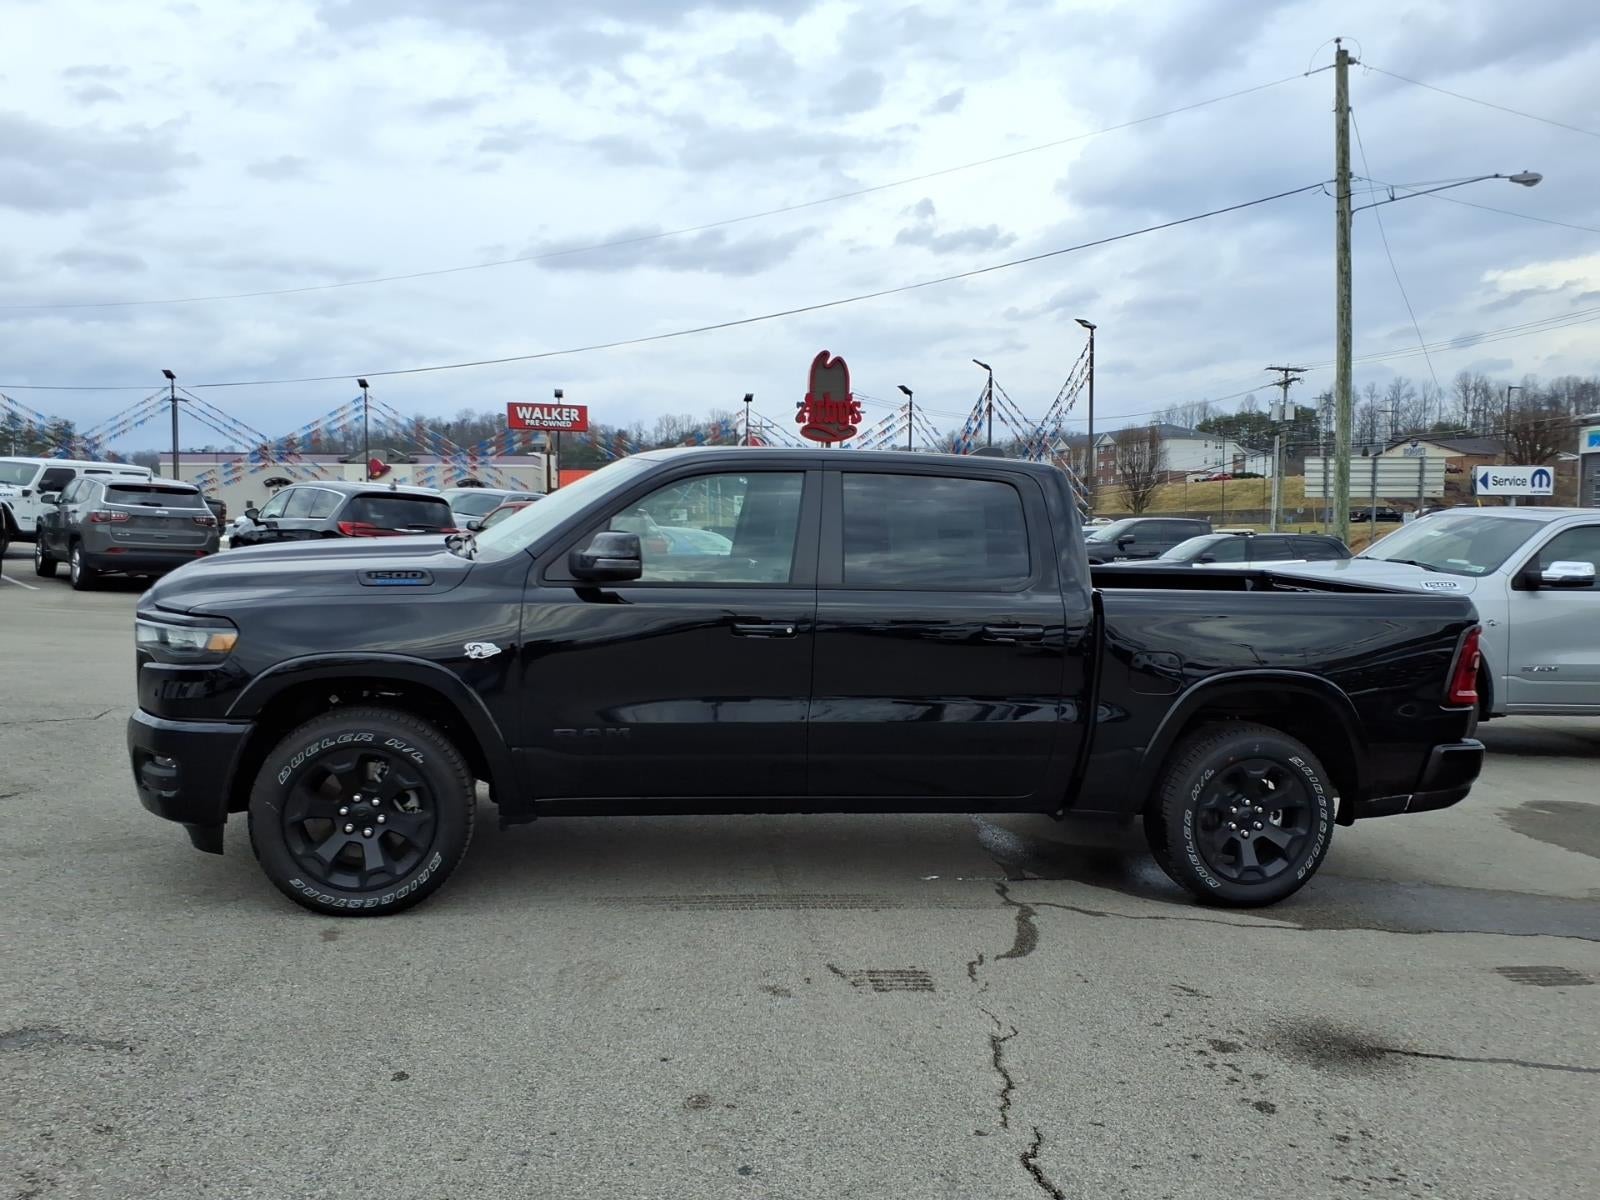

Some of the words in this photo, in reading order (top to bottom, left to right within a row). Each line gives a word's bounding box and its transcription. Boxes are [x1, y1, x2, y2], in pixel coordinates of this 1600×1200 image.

[516, 406, 580, 421] WALKER
[525, 419, 572, 428] PRE-OWNED
[1491, 475, 1527, 487] Service
[368, 571, 423, 579] 1500
[278, 732, 375, 785] DUELER
[1288, 756, 1328, 880] BRIDGESTONE
[1183, 809, 1222, 889] DUELER
[289, 851, 443, 909] BRIDGESTONE
